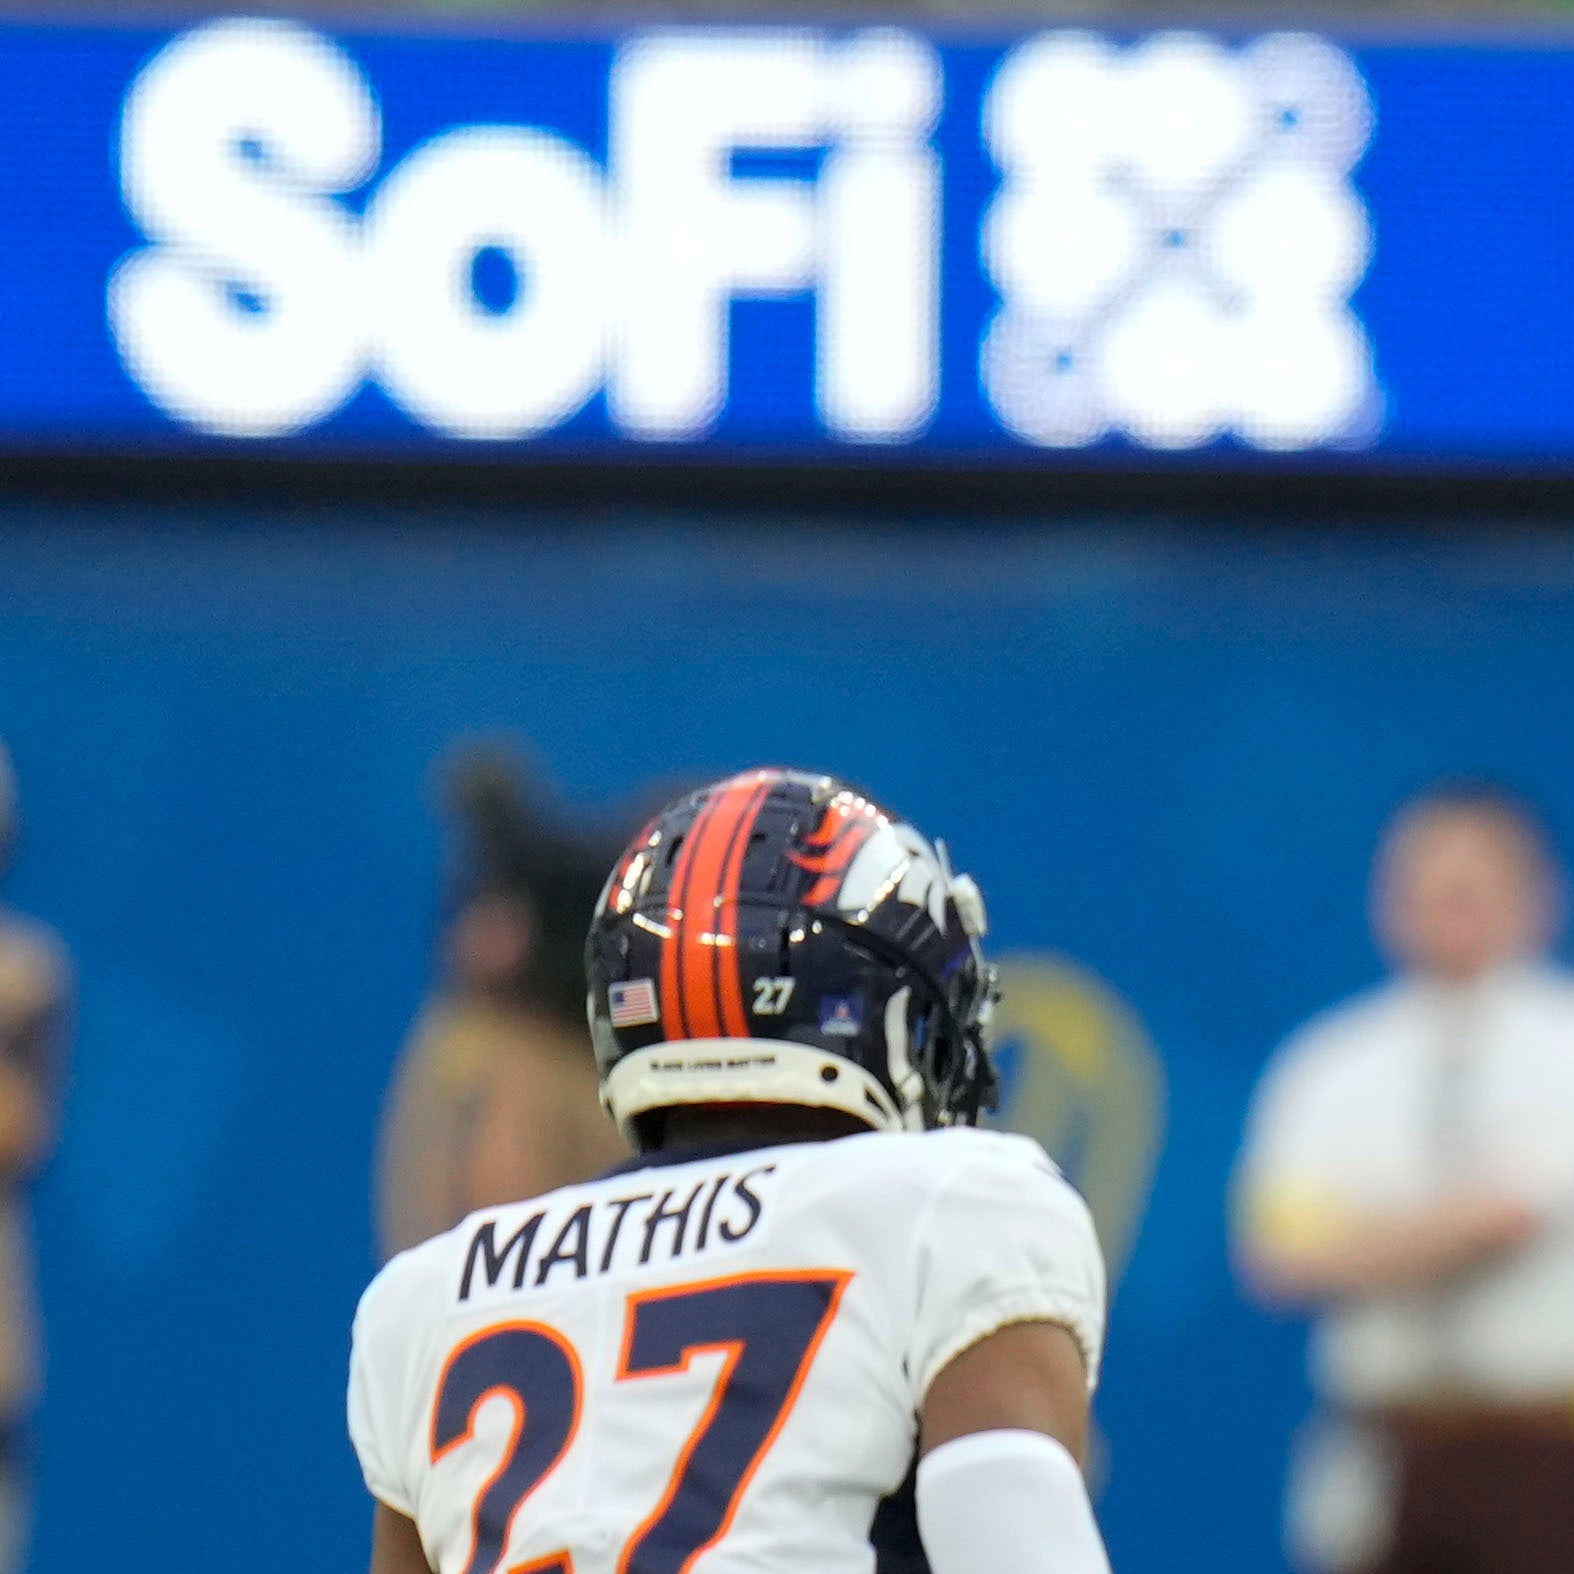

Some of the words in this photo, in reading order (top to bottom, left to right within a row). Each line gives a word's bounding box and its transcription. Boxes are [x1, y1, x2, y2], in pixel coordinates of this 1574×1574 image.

[108, 17, 943, 443] SoFi
[752, 976, 796, 1016] 27
[458, 1164, 777, 1302] MATHIS
